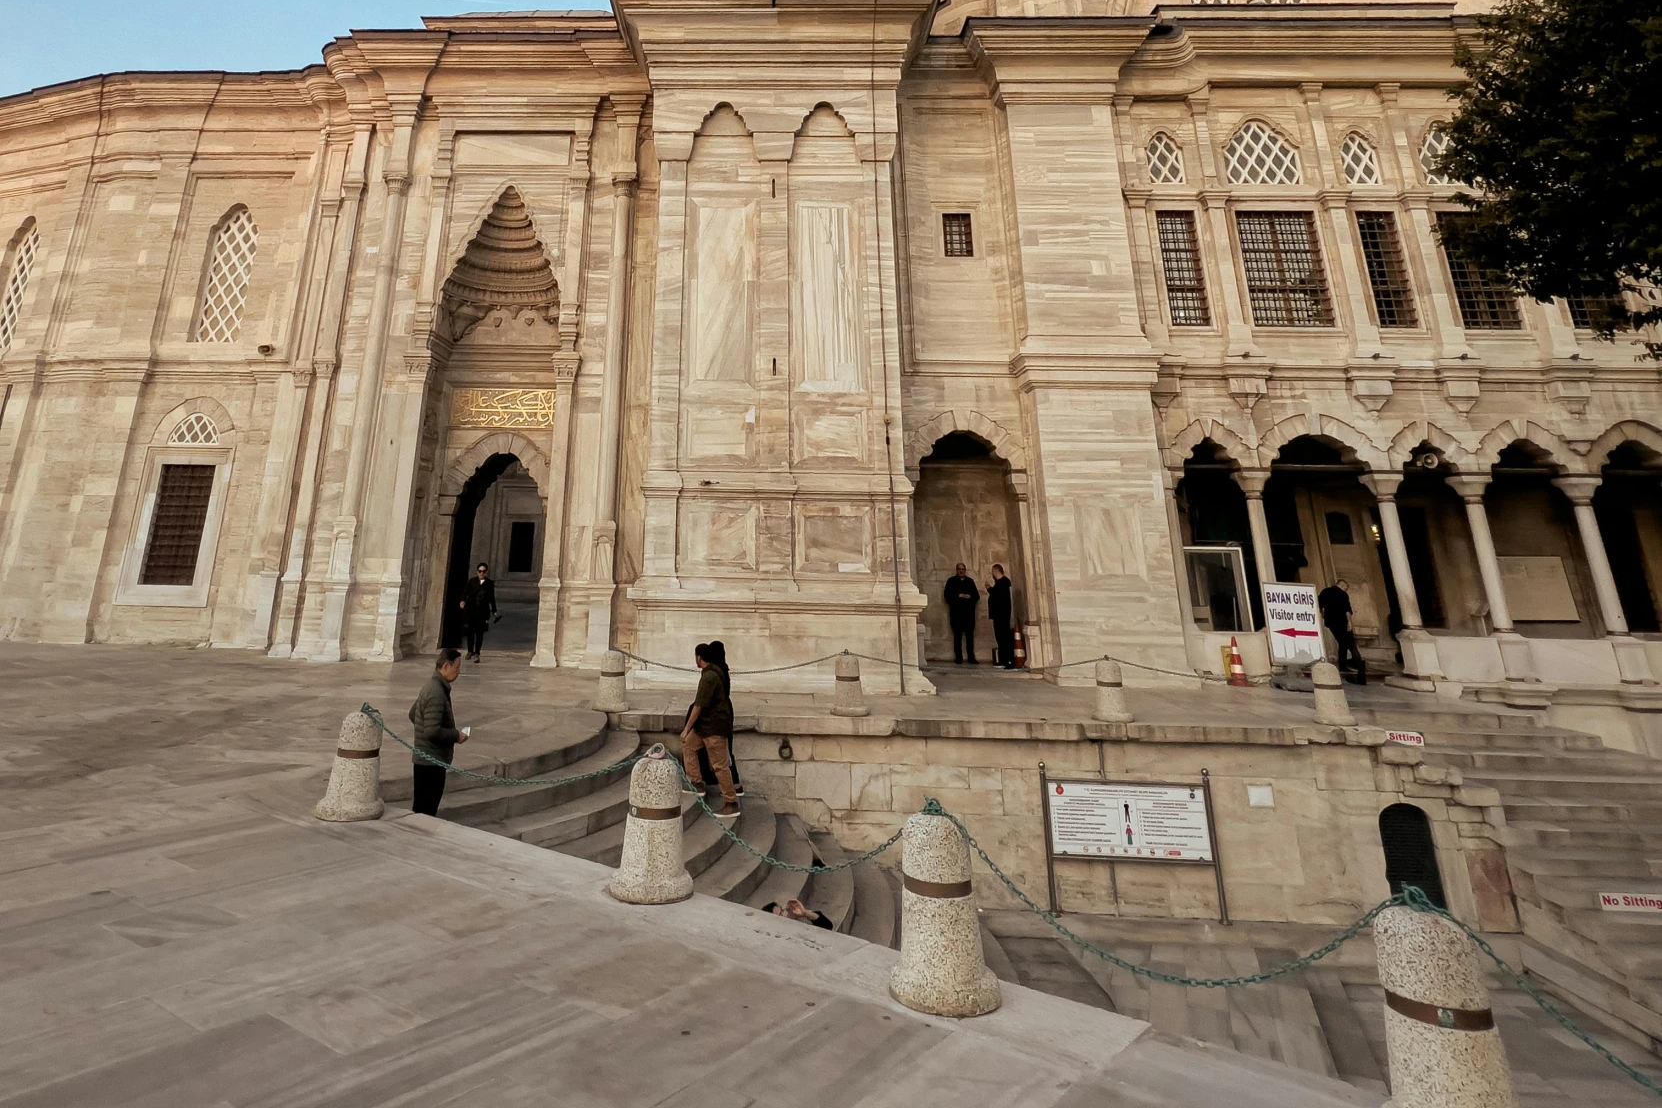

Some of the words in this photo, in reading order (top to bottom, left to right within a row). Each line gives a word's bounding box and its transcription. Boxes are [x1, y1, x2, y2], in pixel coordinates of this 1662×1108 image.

[1266, 591, 1292, 604] BAYAN
[1293, 591, 1315, 608] GİRİŞ
[1269, 608, 1294, 621] Visitor
[1296, 611, 1316, 625] entry
[1389, 732, 1422, 744] Sitting
[1602, 895, 1620, 906] No
[1622, 896, 1662, 910] Sitting
